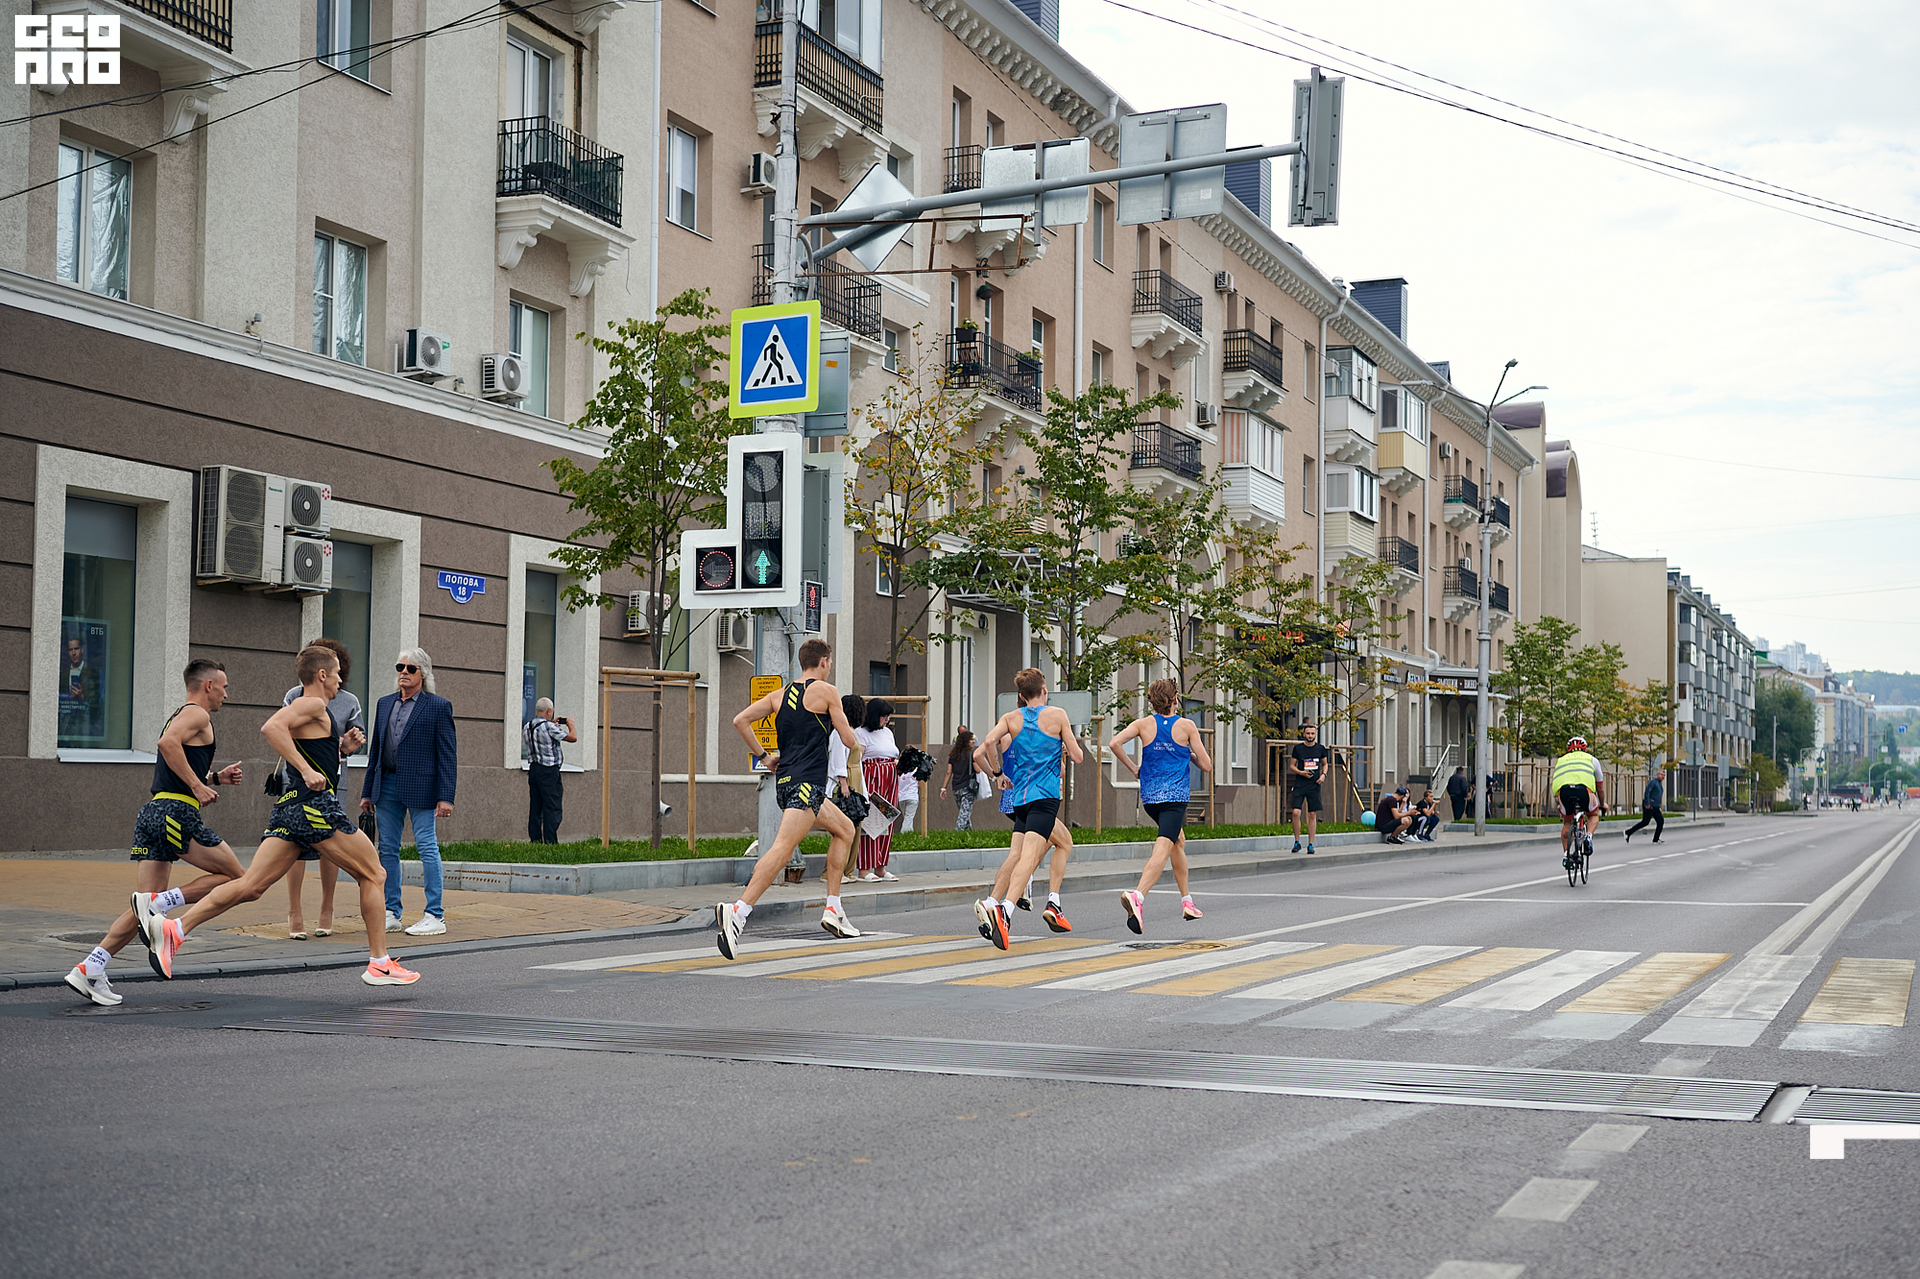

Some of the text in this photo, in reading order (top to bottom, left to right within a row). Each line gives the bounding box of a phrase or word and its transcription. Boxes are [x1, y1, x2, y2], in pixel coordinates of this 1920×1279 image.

[445, 574, 479, 587] ПОПОВА
[458, 586, 467, 596] 18
[90, 626, 104, 636] ВТБ
[761, 736, 770, 744] 90
